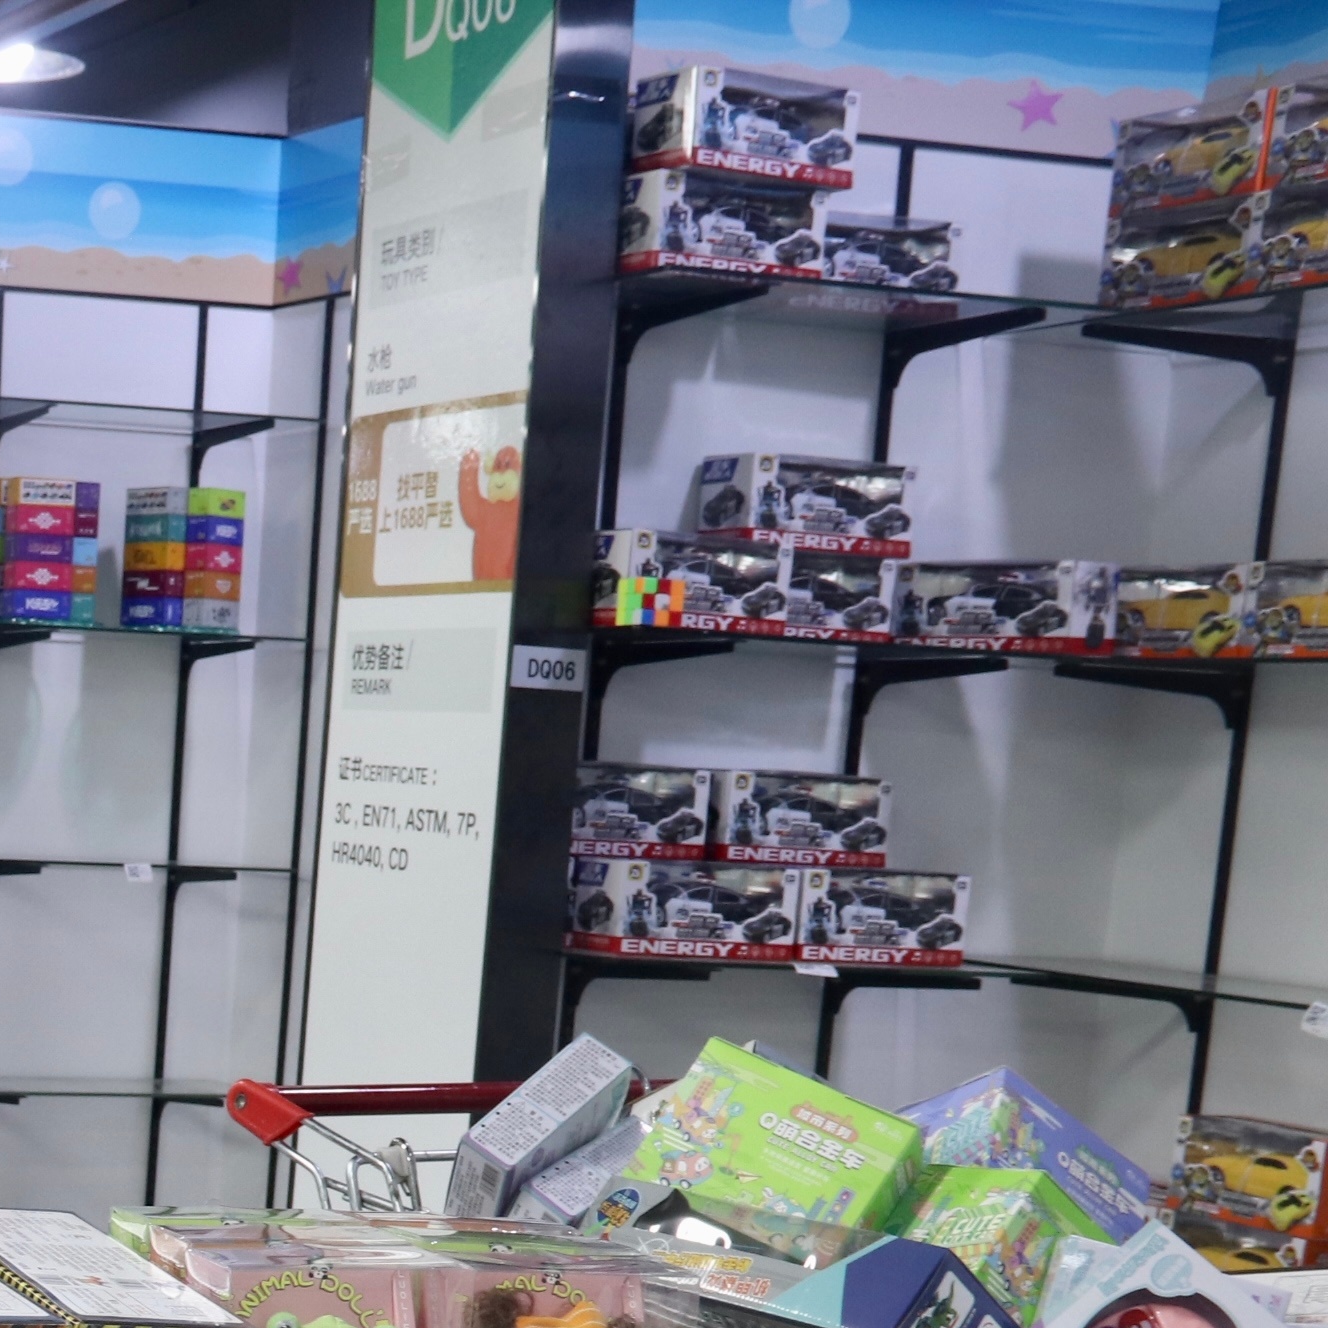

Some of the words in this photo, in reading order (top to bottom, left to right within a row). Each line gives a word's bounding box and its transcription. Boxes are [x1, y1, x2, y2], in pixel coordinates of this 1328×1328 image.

[696, 149, 801, 179] ENERGY
[381, 270, 401, 292] TOY
[402, 266, 428, 288] TYPE
[367, 347, 392, 373] 水枪
[366, 377, 395, 397] Water
[397, 375, 417, 396] gun
[752, 530, 858, 552] ENERGY
[527, 658, 575, 682] DQ06
[351, 677, 392, 697] REMARK
[727, 845, 832, 865] ENERGY
[620, 937, 734, 958] ENERGY
[801, 944, 908, 965] ENERGY
[758, 1112, 866, 1172] Q萌合金车
